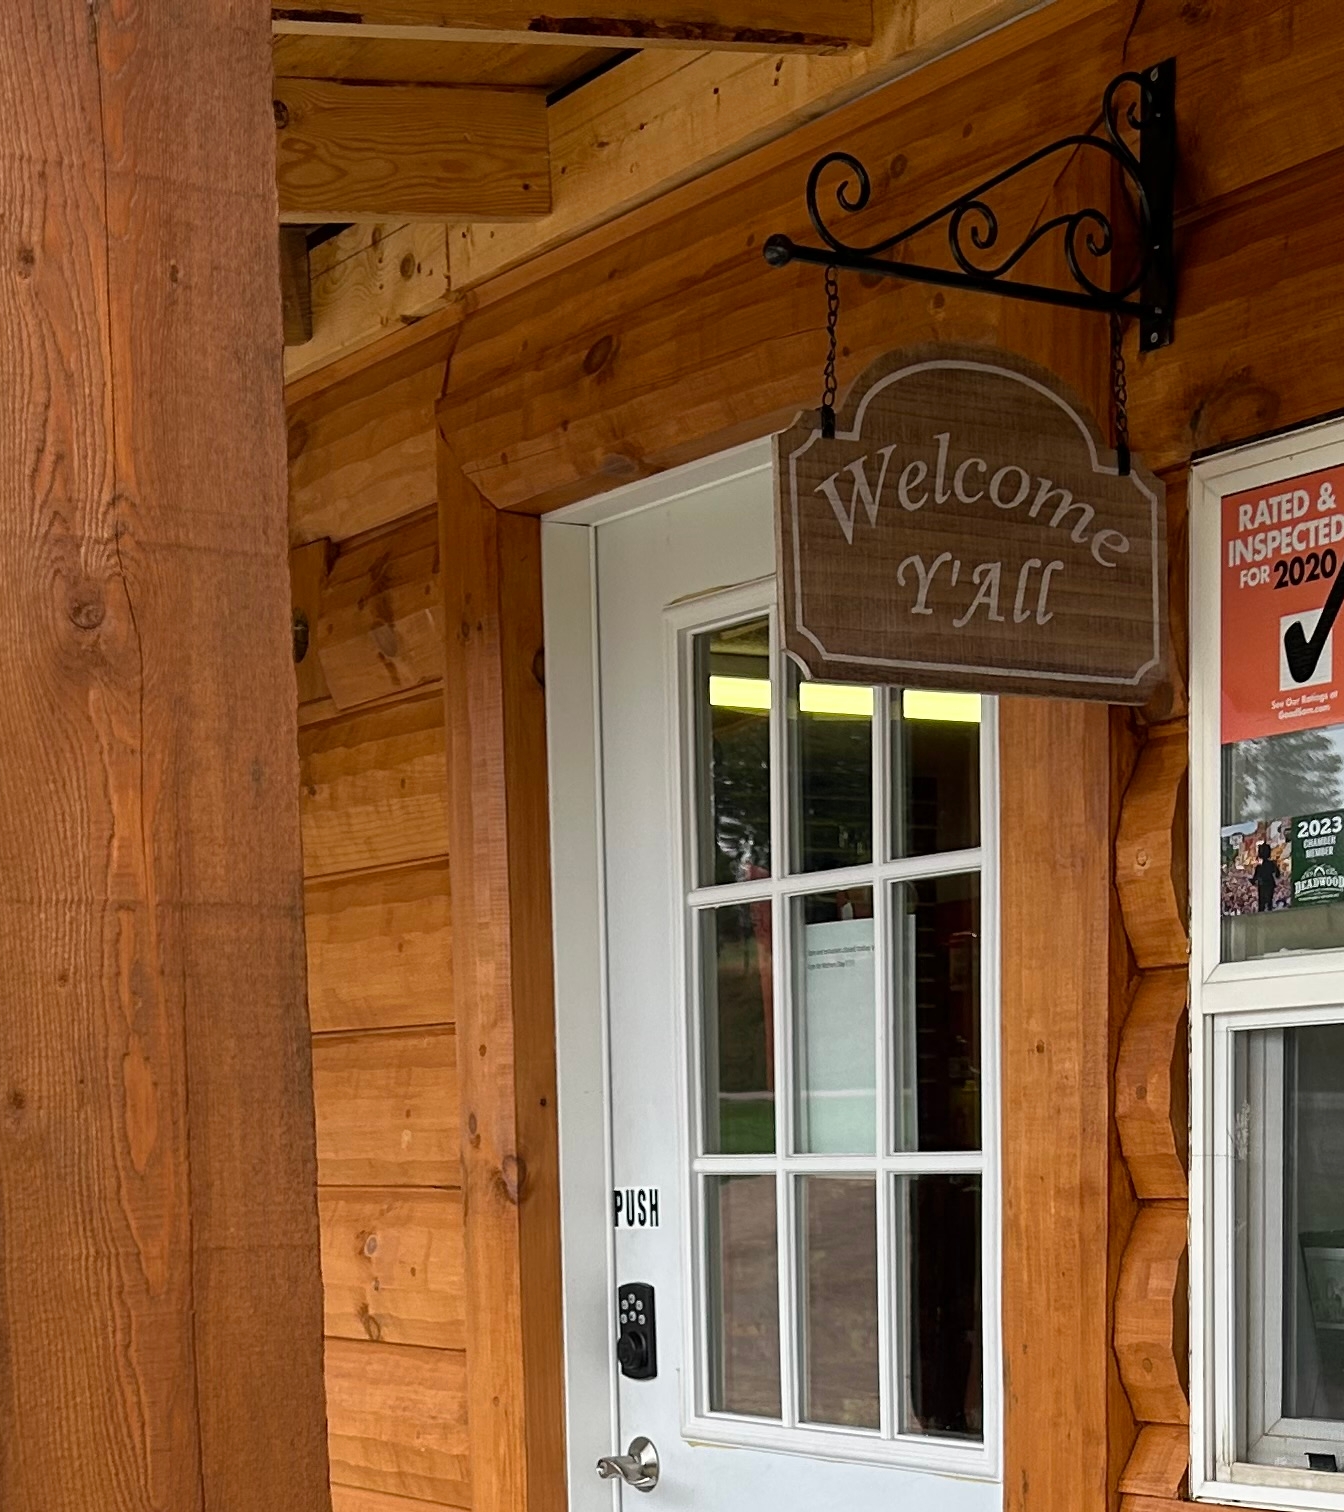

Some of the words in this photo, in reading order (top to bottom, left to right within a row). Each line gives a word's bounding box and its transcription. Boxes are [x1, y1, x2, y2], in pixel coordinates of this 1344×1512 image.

[814, 432, 1131, 568] Welcome
[1239, 488, 1310, 532] RATED
[1317, 482, 1337, 512] &
[897, 551, 1064, 628] Y'All
[1240, 565, 1270, 589] FOR
[1273, 548, 1338, 590] 2020
[1297, 815, 1343, 838] 2023
[614, 1188, 659, 1227] PUSH
